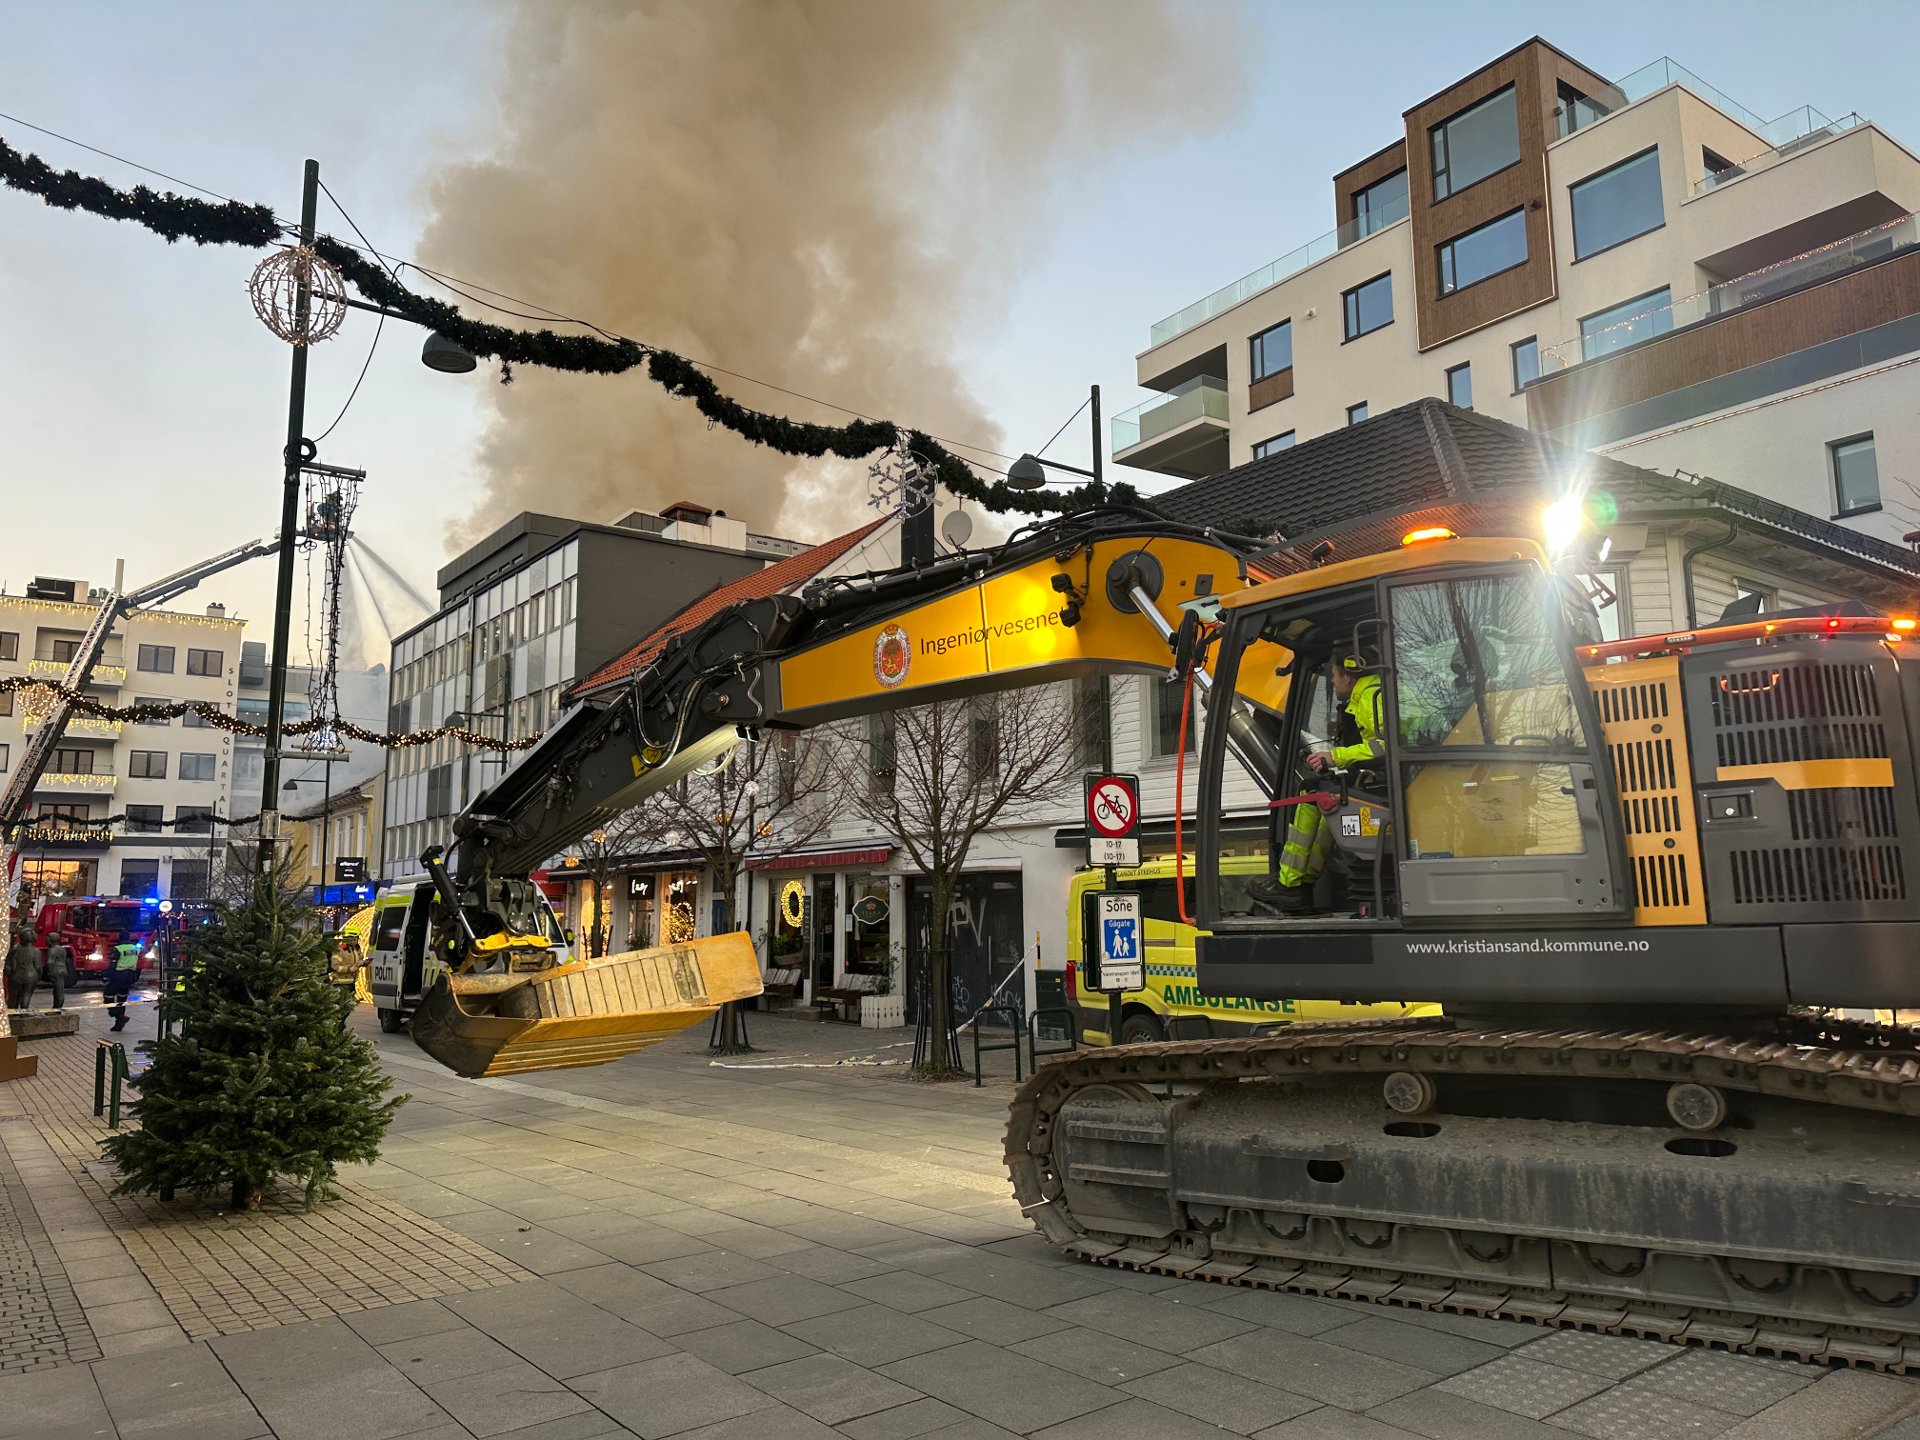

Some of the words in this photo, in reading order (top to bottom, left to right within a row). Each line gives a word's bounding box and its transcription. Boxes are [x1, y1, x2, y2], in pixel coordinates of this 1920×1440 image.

[920, 610, 1060, 655] Ingeniørvesene
[216, 667, 235, 838] SLOTQUARTALT
[1343, 823, 1356, 835] 104
[1105, 840, 1122, 848] 10-17
[1103, 852, 1126, 861] (10-17)
[1106, 900, 1133, 913] Sone
[1108, 919, 1131, 929] Gågate
[1406, 938, 1650, 954] www.kristiansand.kommune.no
[374, 966, 394, 981] POLITI
[1163, 984, 1297, 1014] AMBULANSE
